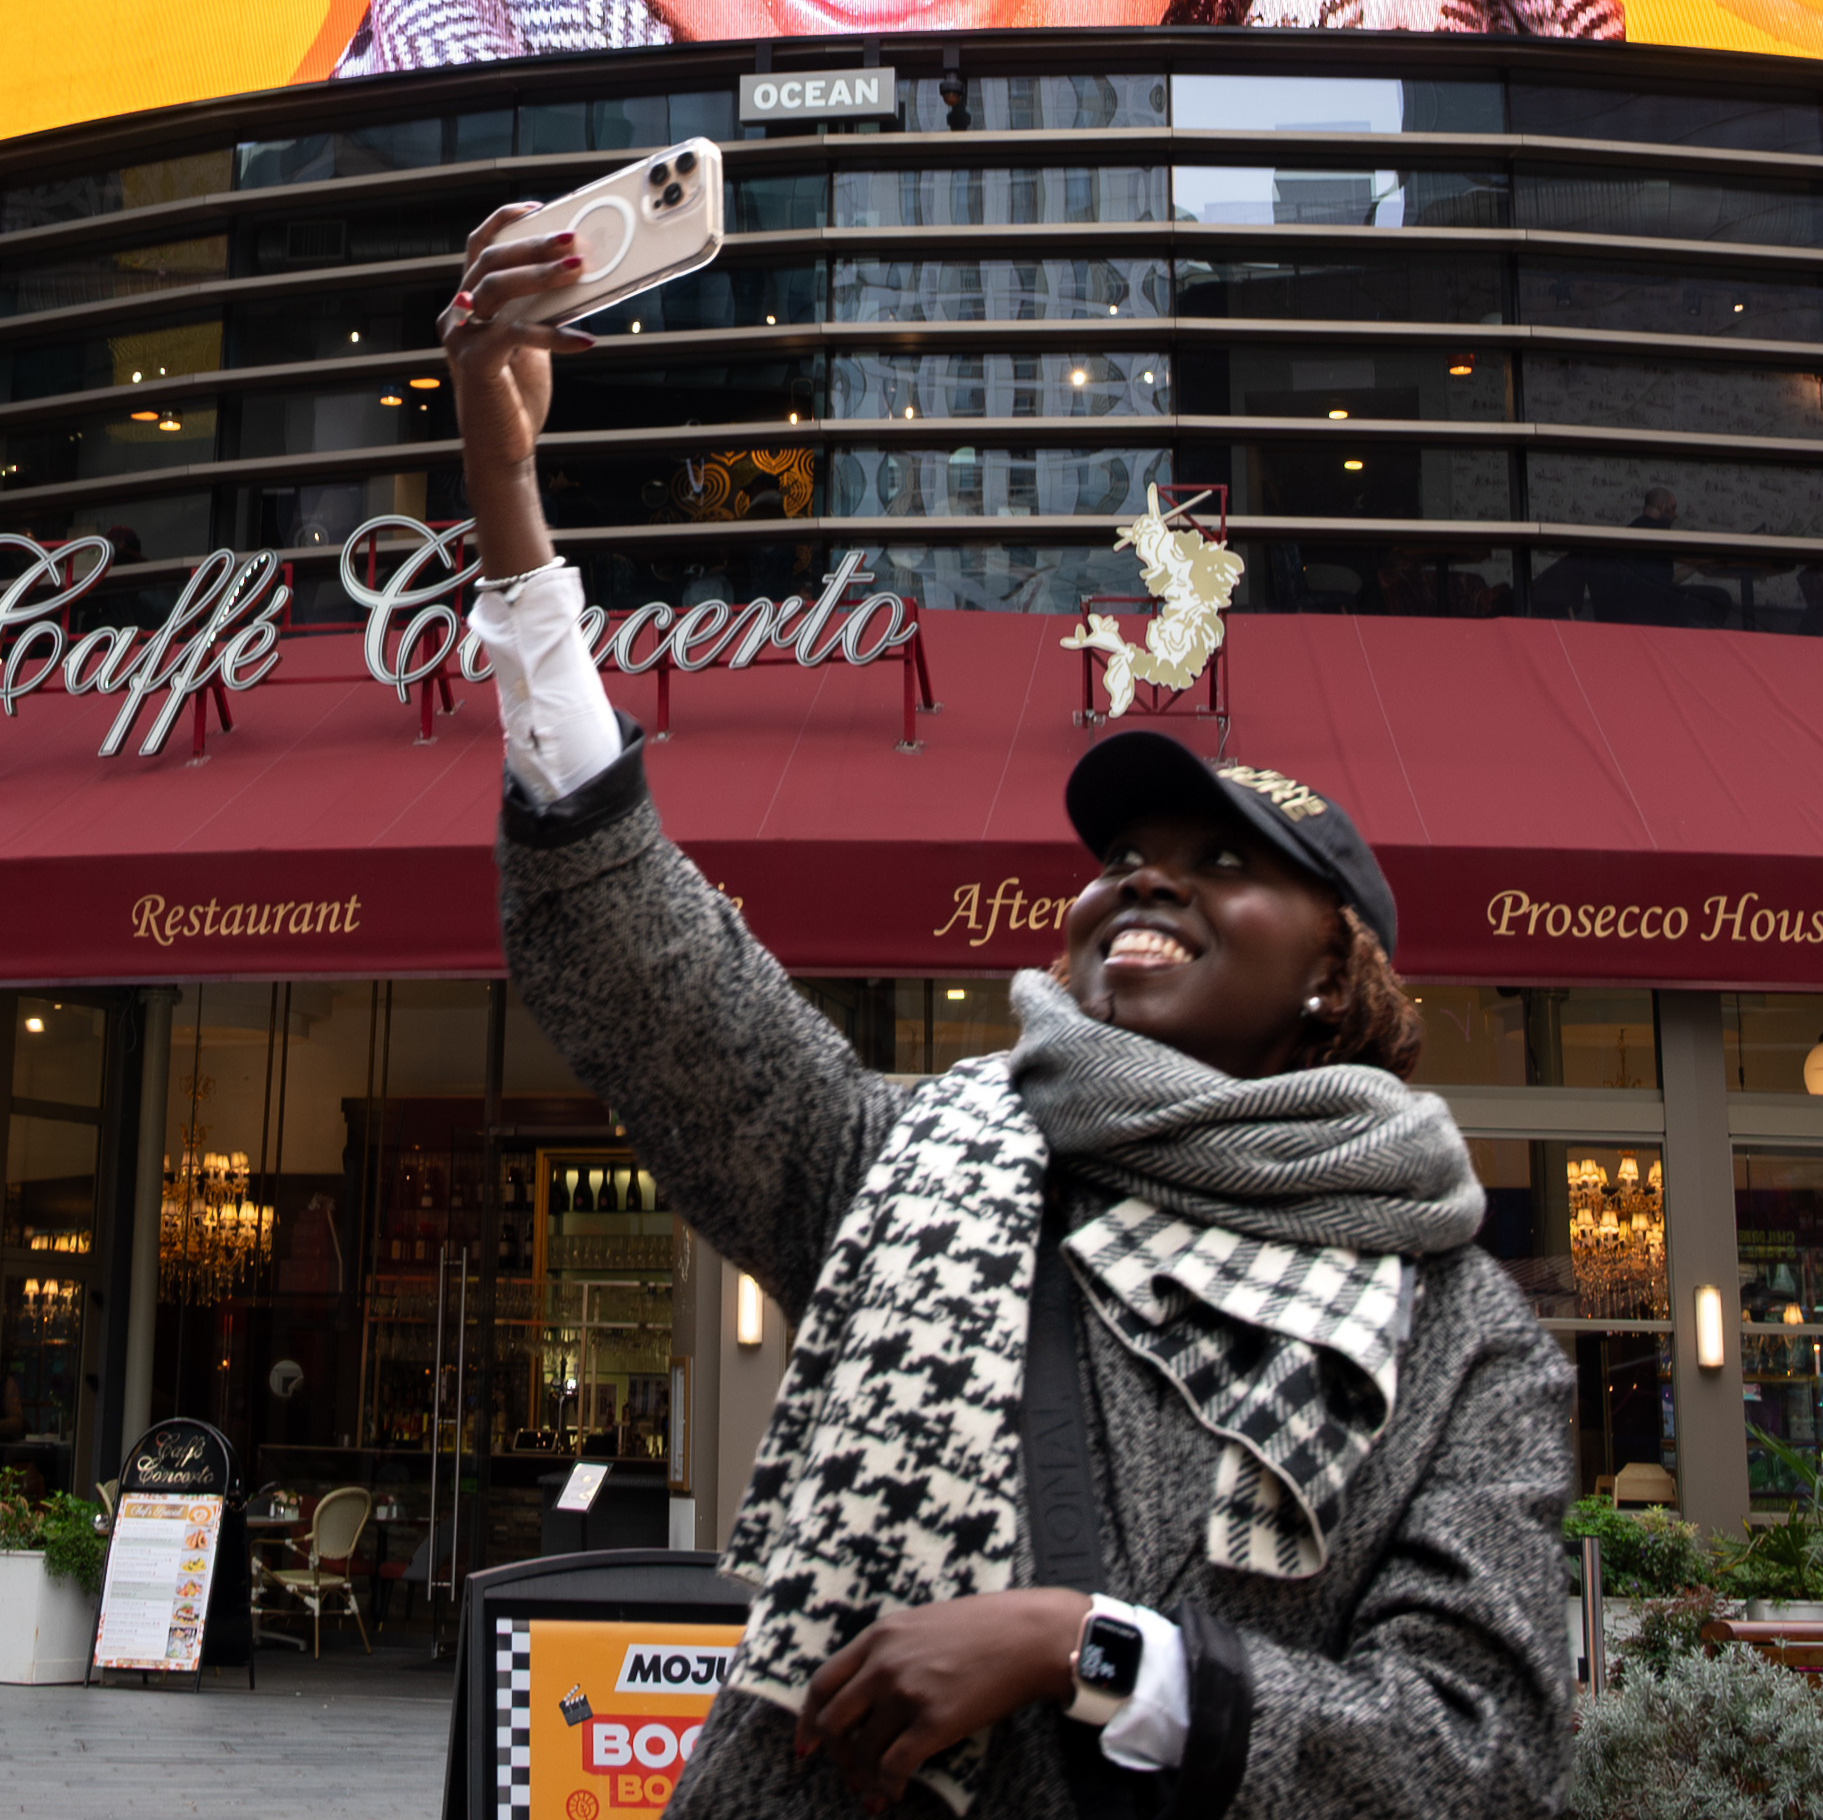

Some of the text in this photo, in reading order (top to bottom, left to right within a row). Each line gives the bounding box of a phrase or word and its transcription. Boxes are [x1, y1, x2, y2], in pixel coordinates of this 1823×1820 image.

[753, 78, 878, 110] OCEAN
[339, 513, 918, 705] Cocerto
[131, 892, 362, 947] Restaurant
[1486, 888, 1689, 941] Prosecco
